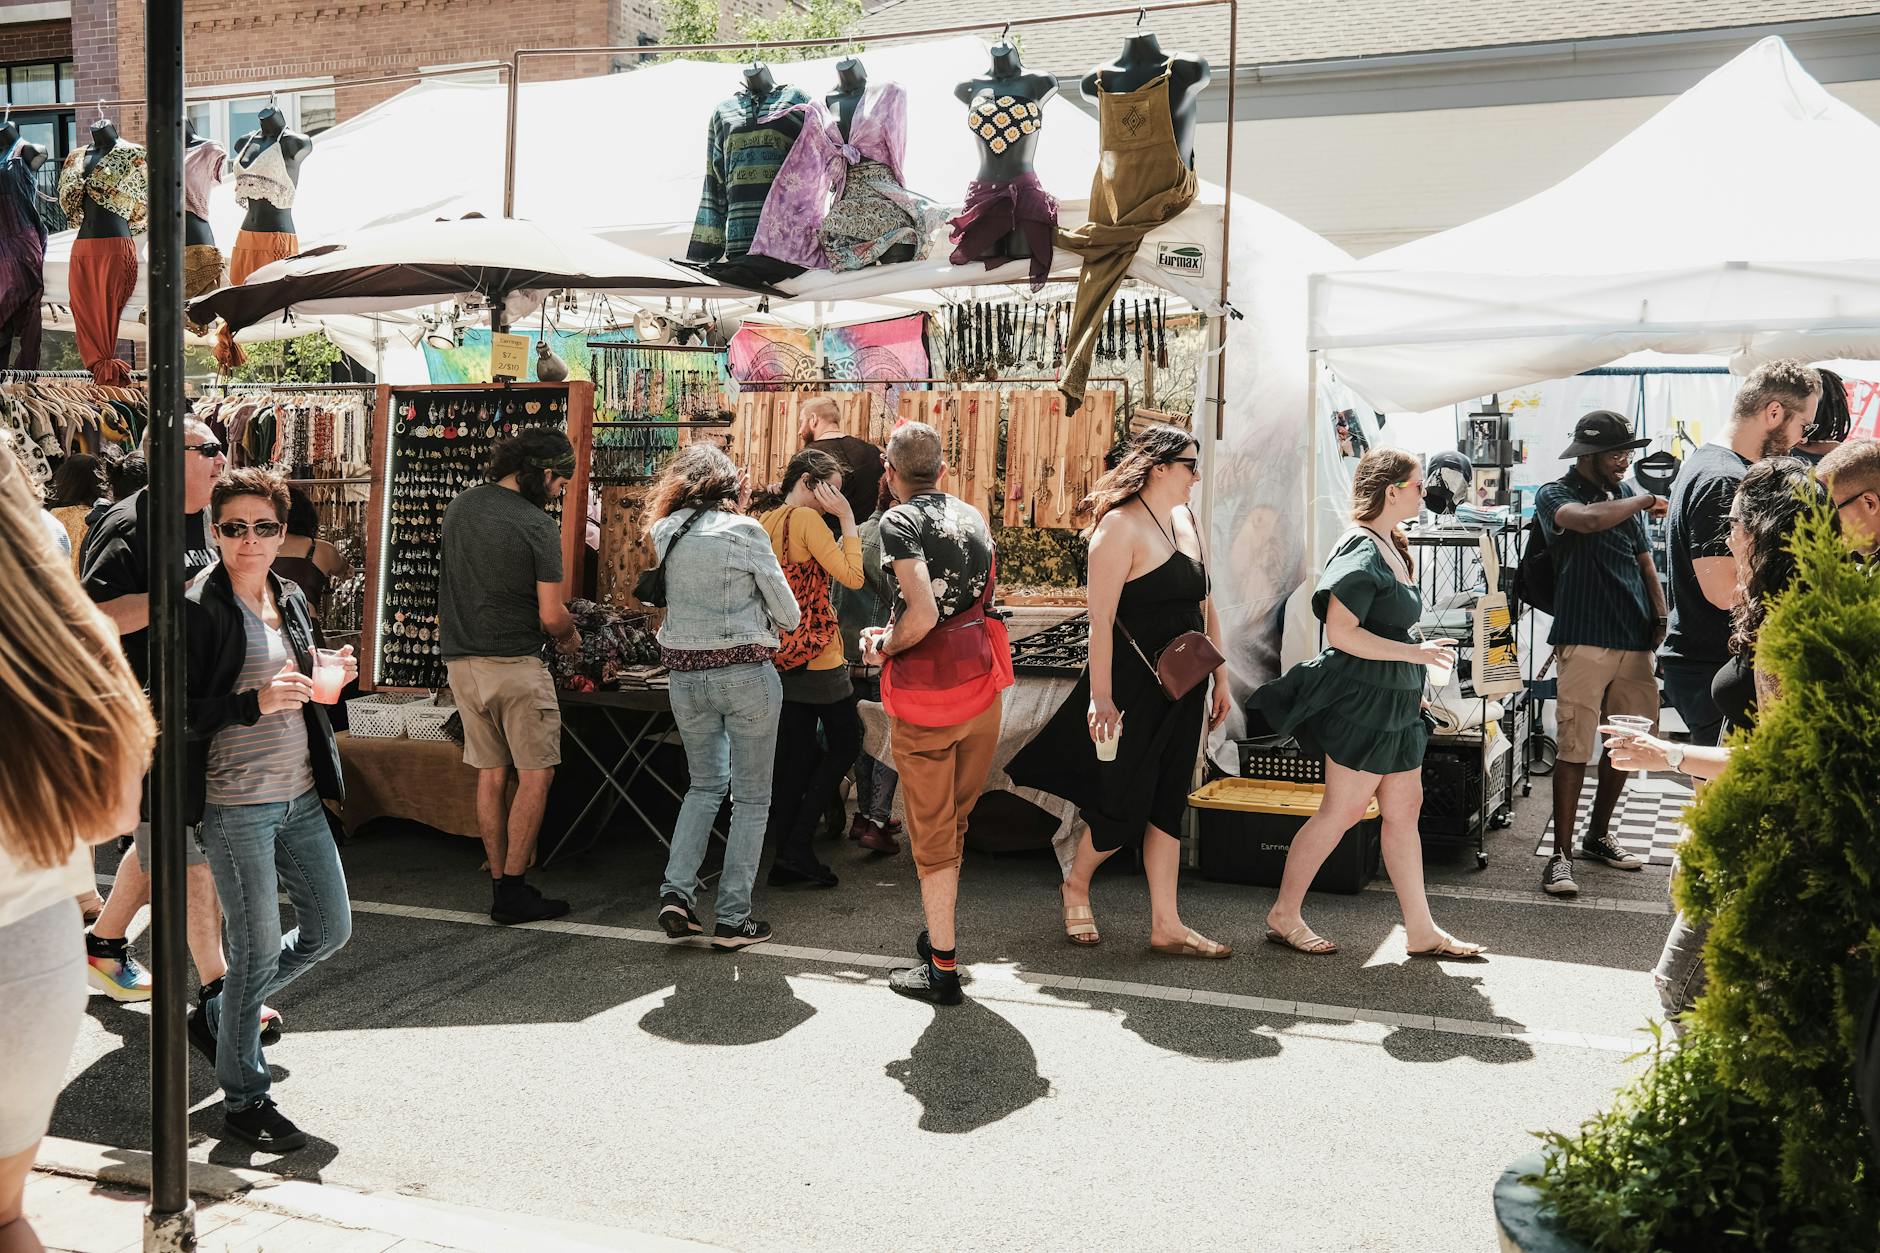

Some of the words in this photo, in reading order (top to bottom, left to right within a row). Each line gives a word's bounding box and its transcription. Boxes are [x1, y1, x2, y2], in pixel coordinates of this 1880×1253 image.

[1159, 253, 1199, 269] Eurmax
[502, 351, 512, 359] $7
[498, 362, 520, 371] 2/$10
